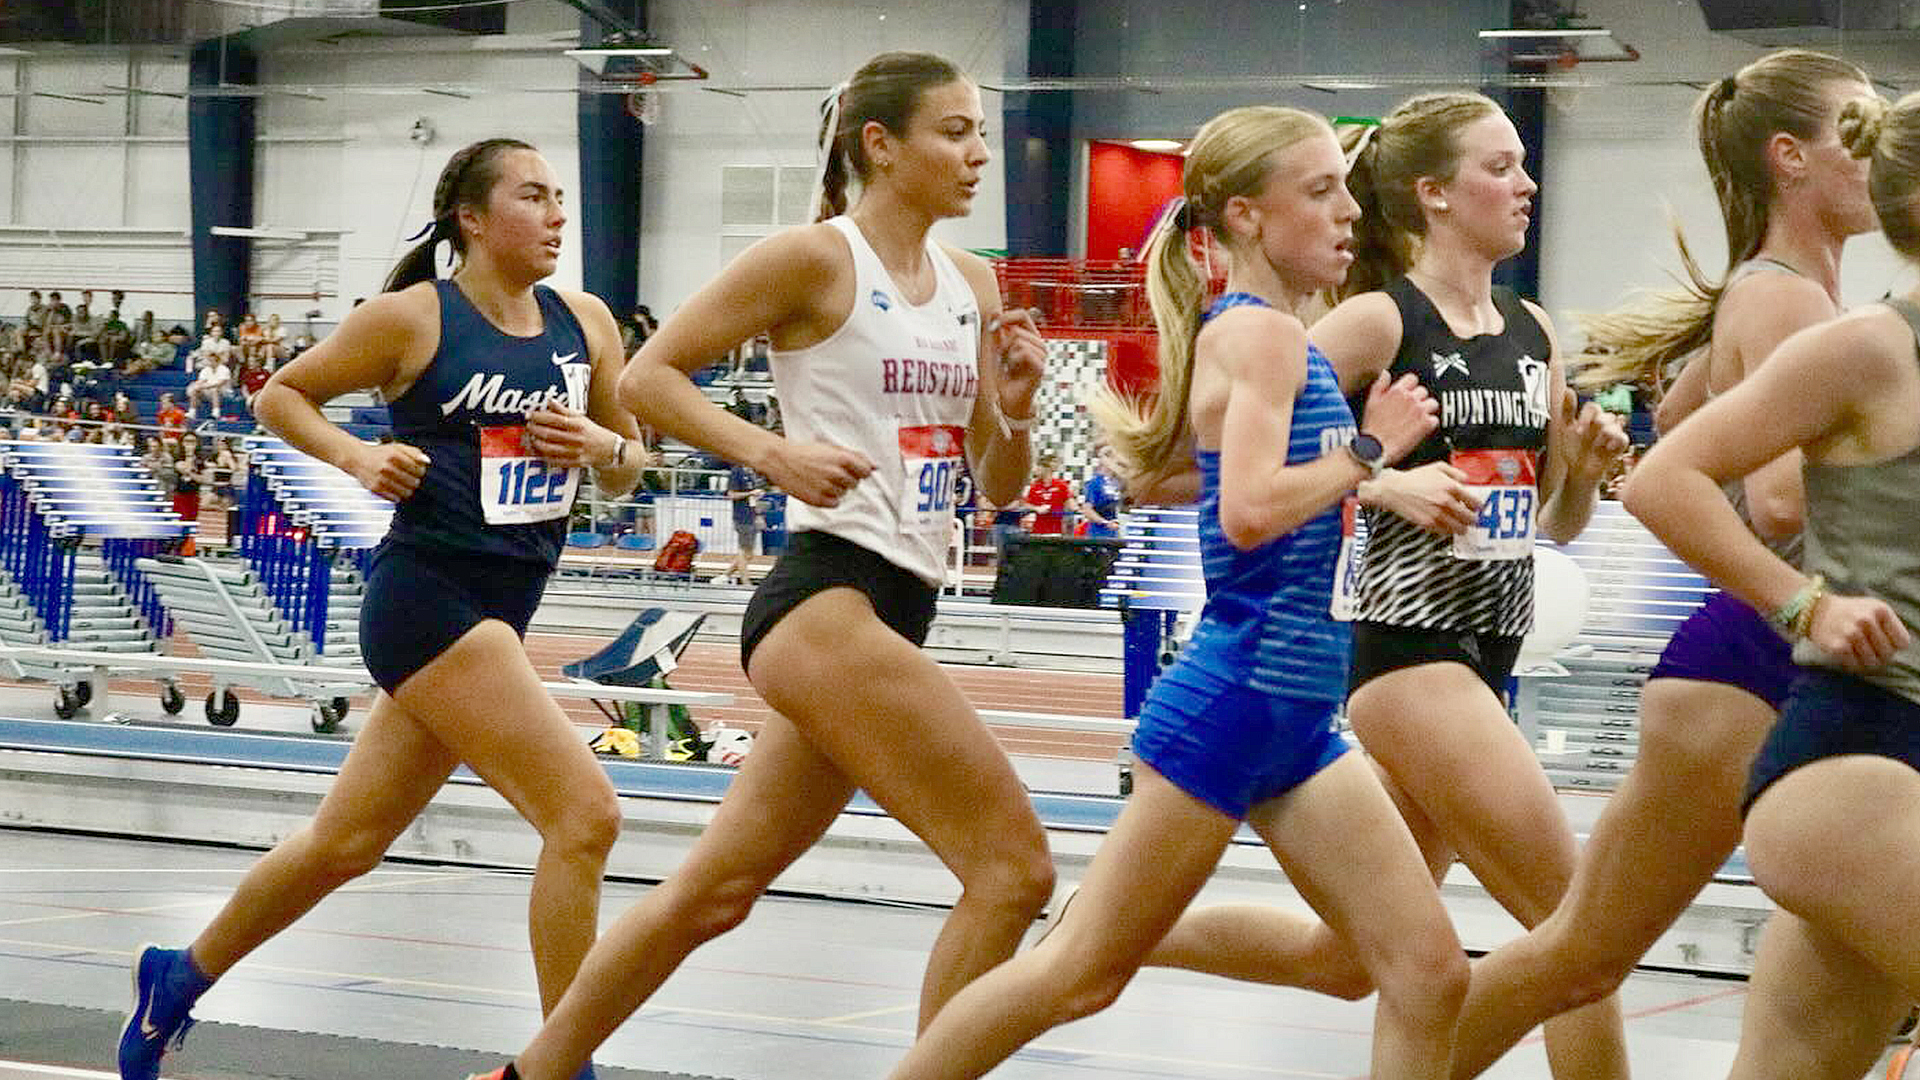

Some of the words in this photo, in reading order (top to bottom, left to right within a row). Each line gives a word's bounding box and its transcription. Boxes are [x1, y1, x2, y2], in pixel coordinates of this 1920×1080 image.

[1441, 389, 1547, 429] HUNTINGT
[498, 458, 570, 505] 1122
[1475, 489, 1533, 540] 433
